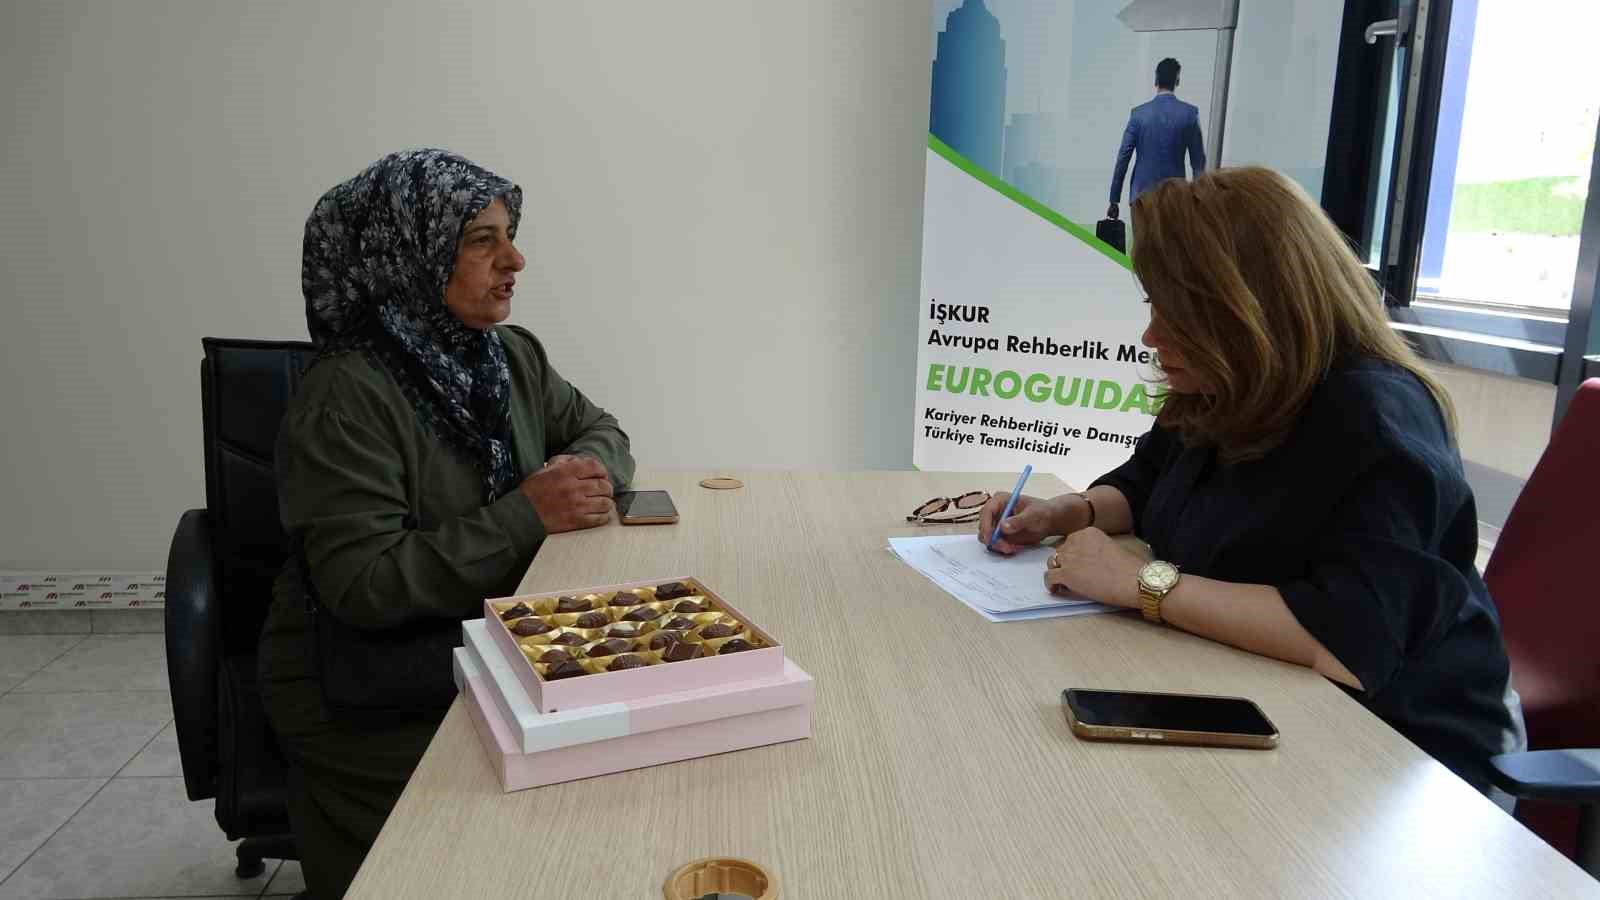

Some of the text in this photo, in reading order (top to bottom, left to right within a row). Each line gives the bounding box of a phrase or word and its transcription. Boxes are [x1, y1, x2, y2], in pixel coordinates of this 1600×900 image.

[930, 299, 990, 324] İŞKUR
[927, 329, 999, 354] Avrupa
[1006, 335, 1109, 361] Rehberlik
[924, 407, 977, 428] Kariyer
[980, 414, 1059, 438] Rehberliği
[1062, 426, 1082, 438] ve
[924, 426, 1071, 457] Türkiye Temsilcisidir
